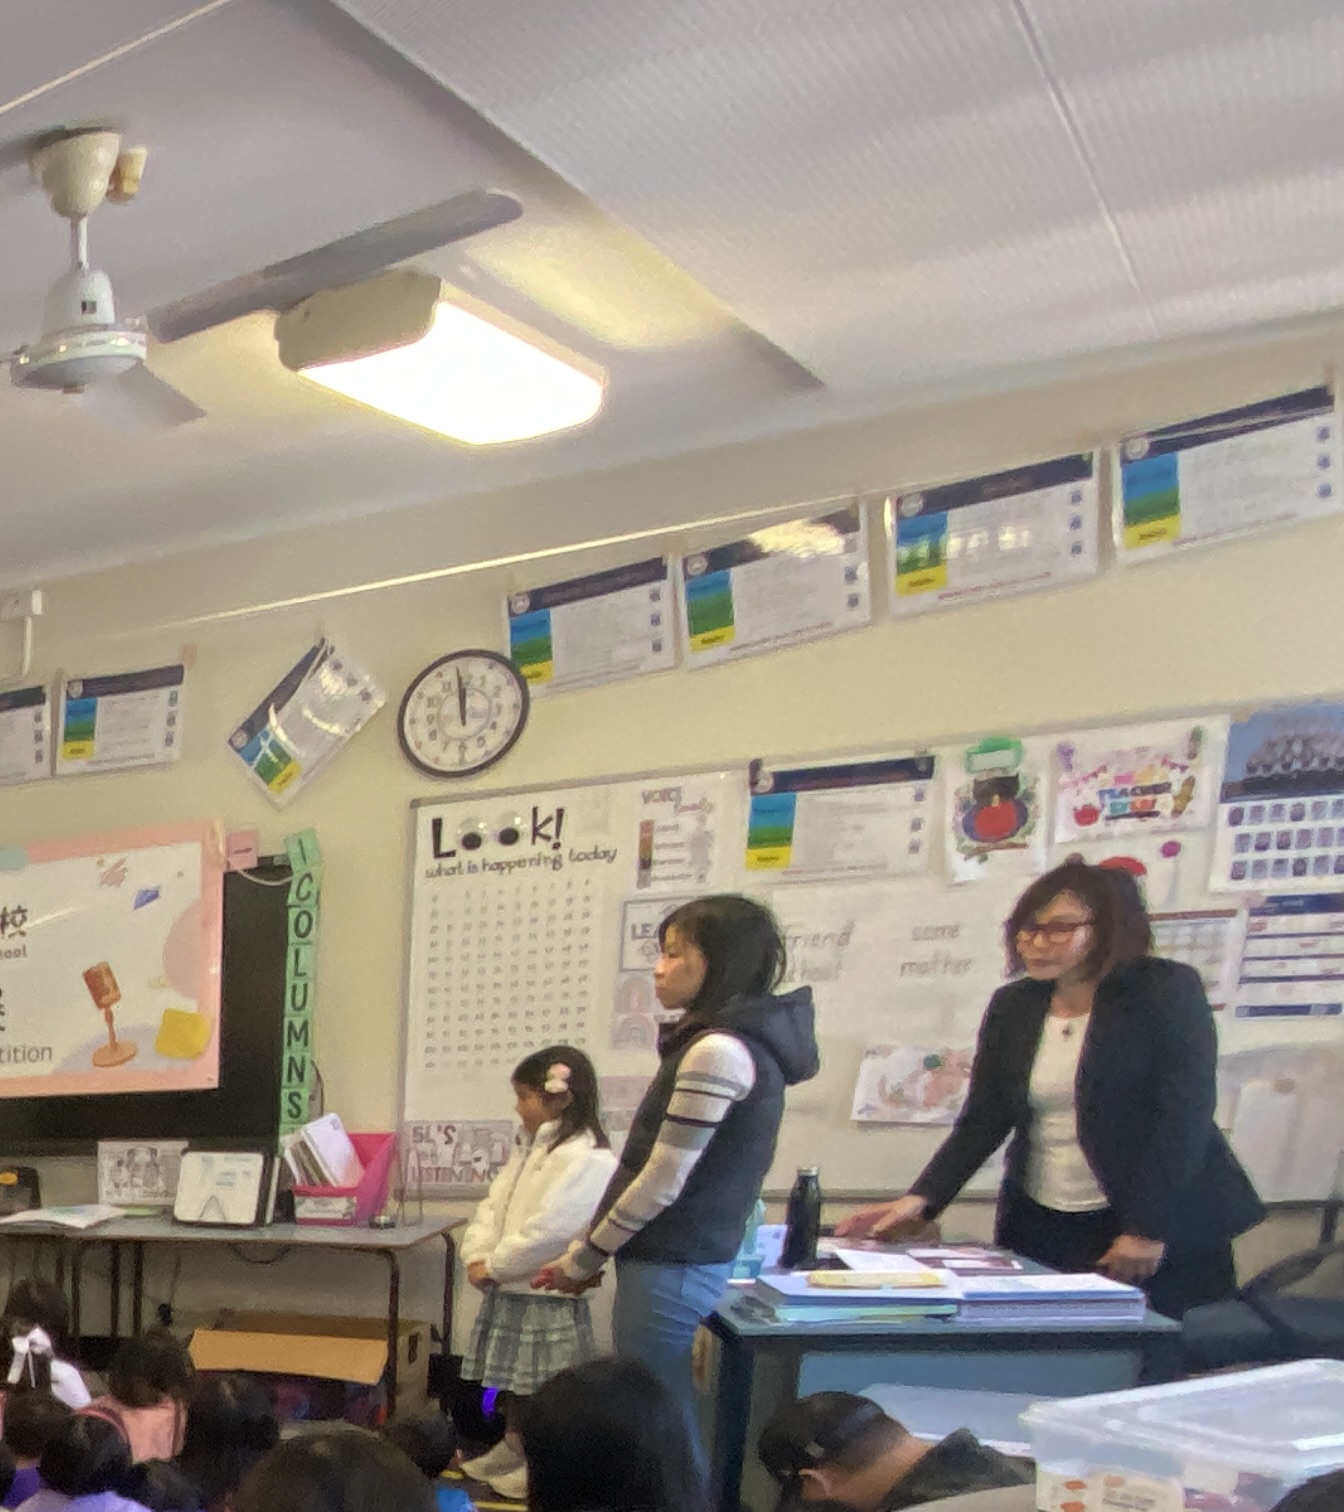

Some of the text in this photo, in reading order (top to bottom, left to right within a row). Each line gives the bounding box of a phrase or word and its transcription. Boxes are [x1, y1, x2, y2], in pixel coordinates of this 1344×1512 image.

[431, 805, 565, 860] Look!
[425, 843, 619, 879] what is happening today
[285, 872, 314, 1120] COLUMNS
